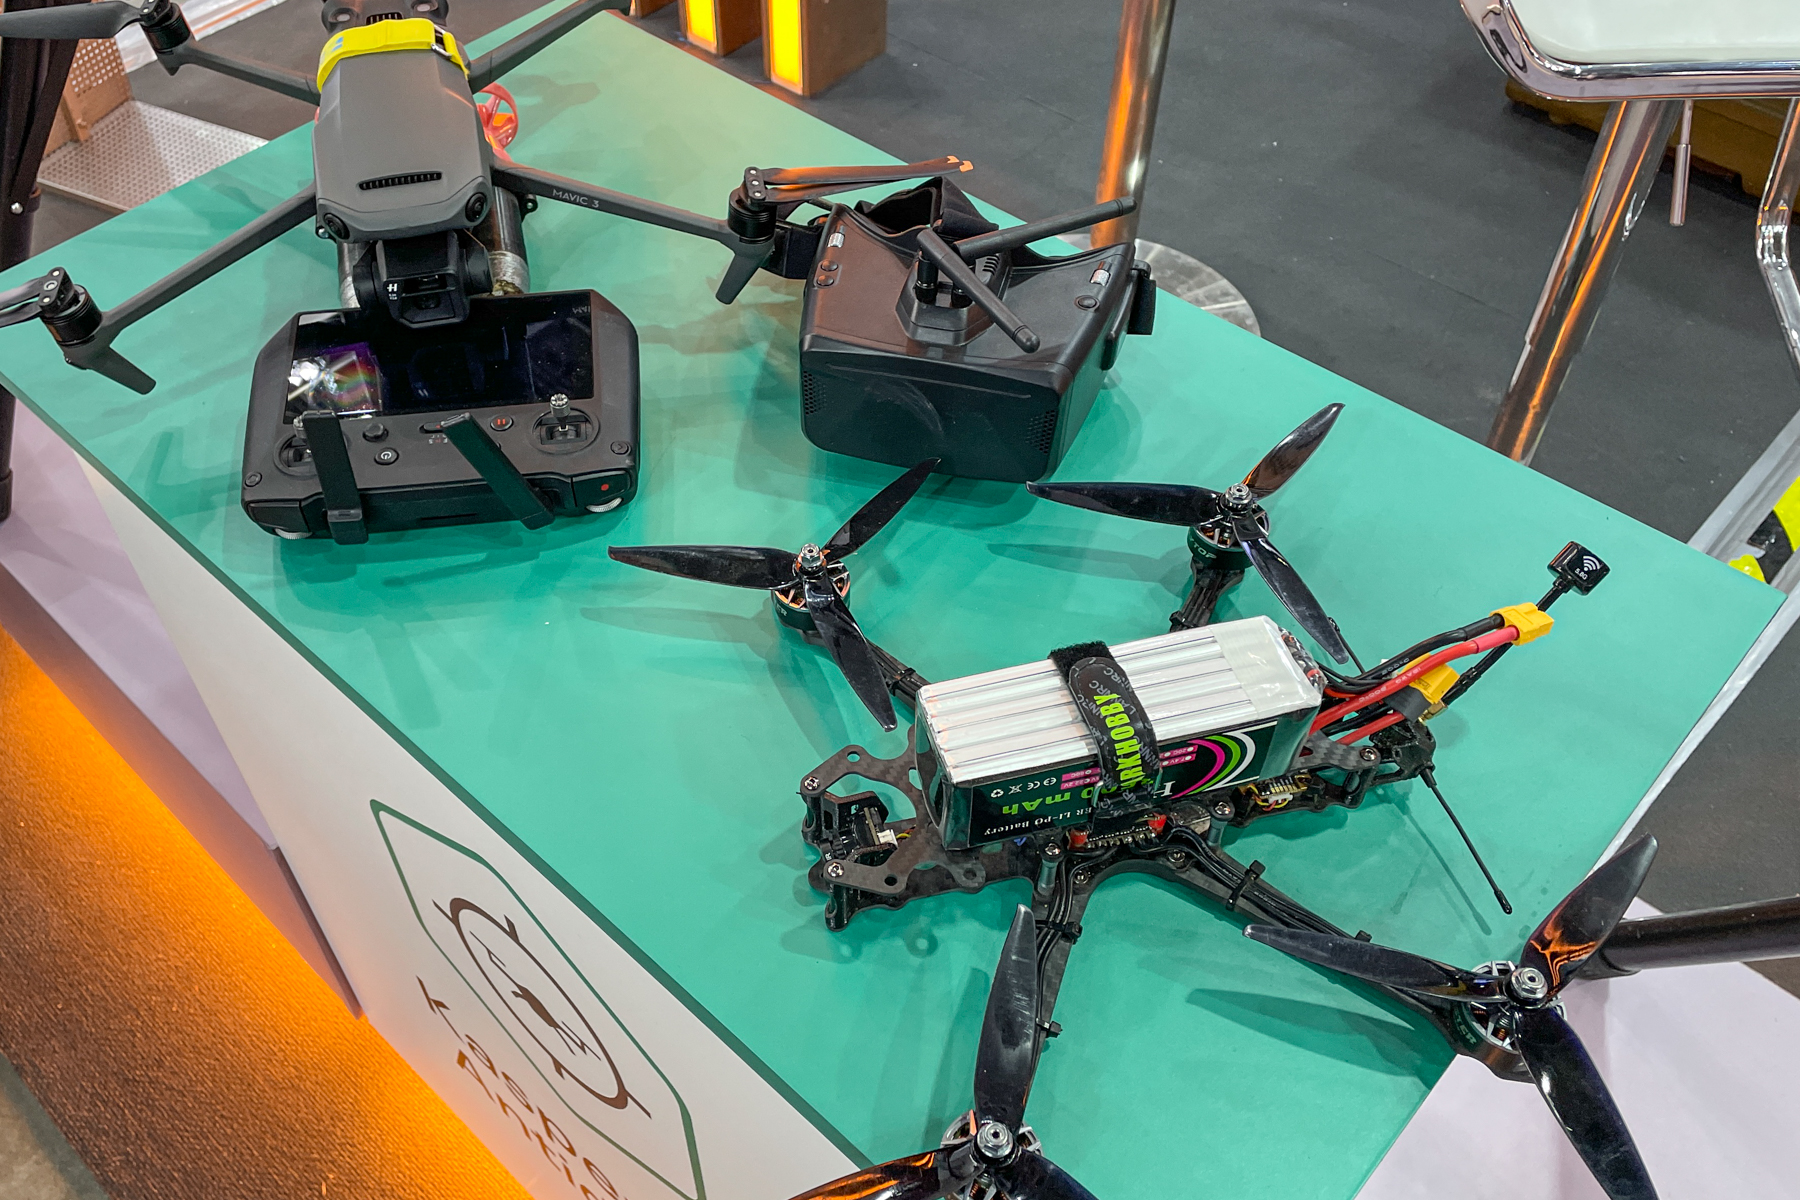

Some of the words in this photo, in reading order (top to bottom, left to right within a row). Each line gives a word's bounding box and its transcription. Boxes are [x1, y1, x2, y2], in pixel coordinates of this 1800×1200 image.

[552, 189, 588, 205] MAVIC
[592, 200, 600, 208] 3
[1002, 791, 1072, 815] mAh
[984, 821, 1030, 836] Battery
[416, 974, 630, 1200] Kaspe
